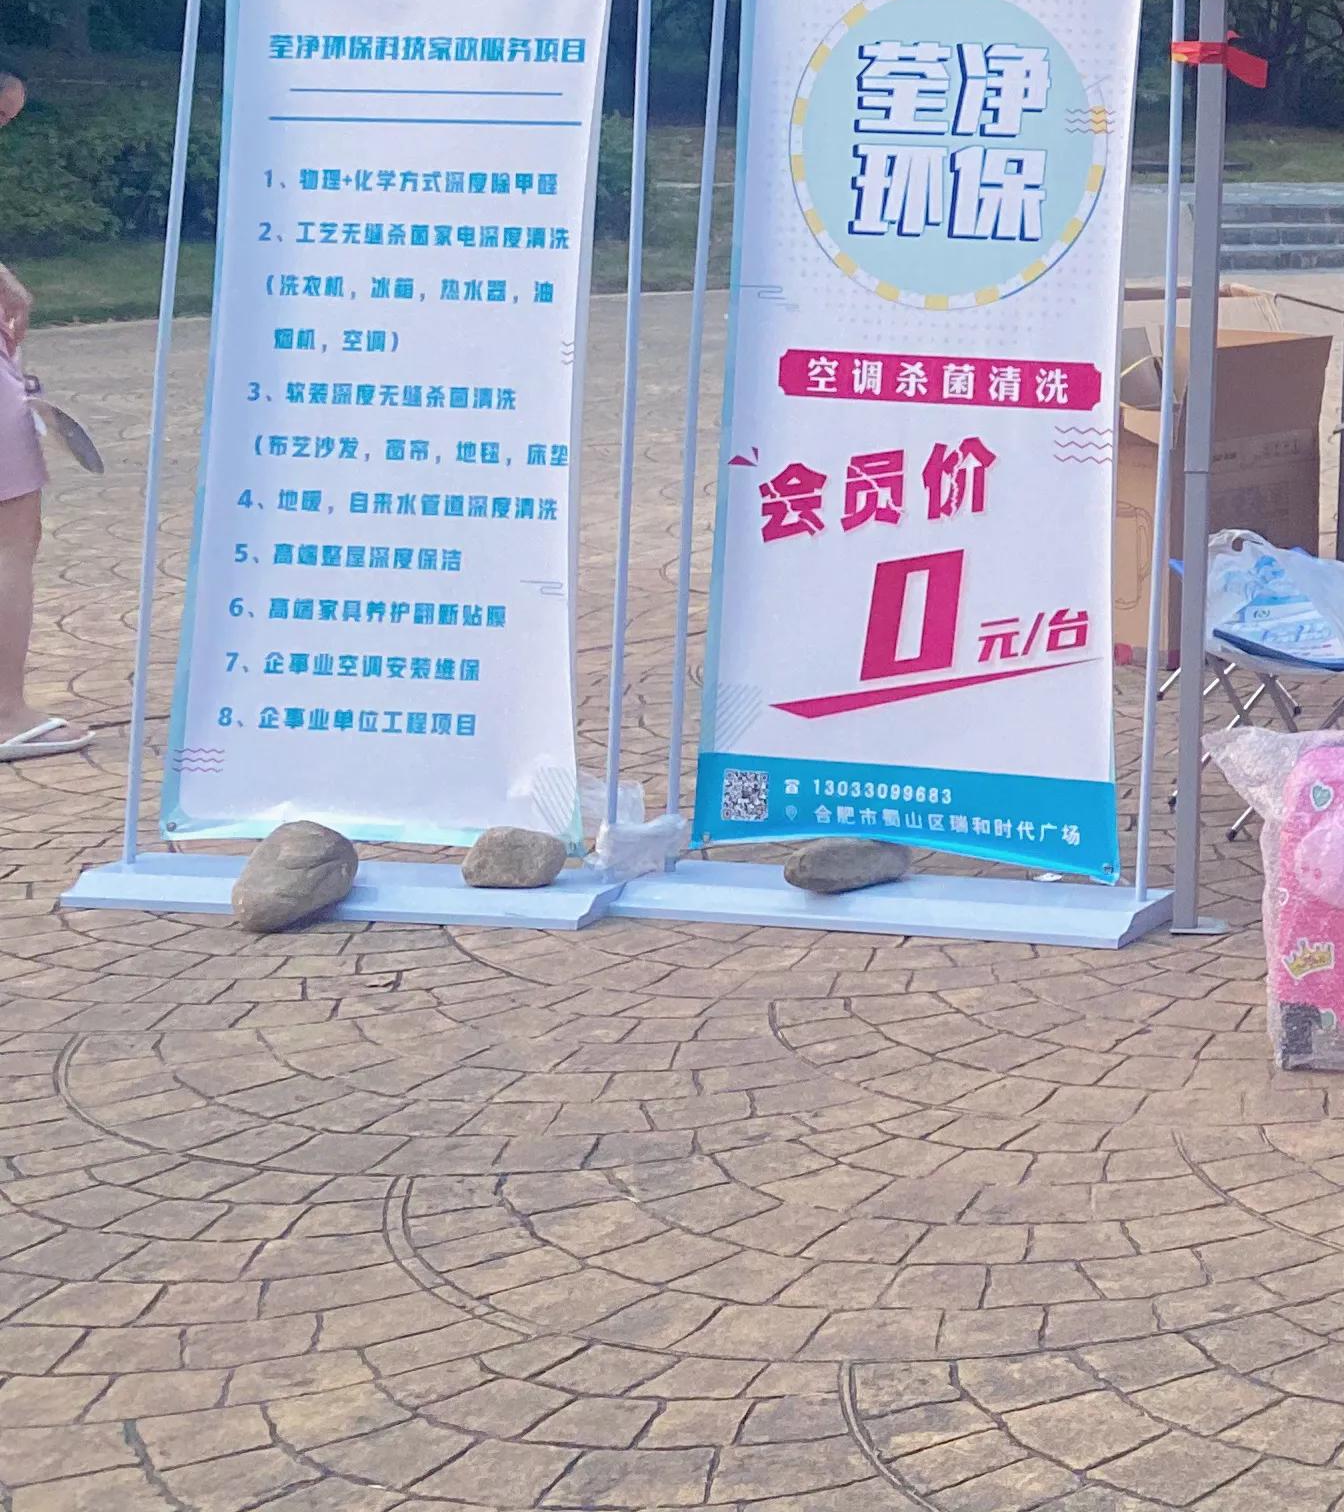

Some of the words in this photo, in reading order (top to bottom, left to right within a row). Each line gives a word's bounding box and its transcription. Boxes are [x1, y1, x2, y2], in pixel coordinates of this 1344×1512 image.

[268, 34, 588, 64] 荃净环保科技家政服务项目
[806, 356, 1070, 405] 空调杀菌清洗
[757, 435, 997, 543] 会员价
